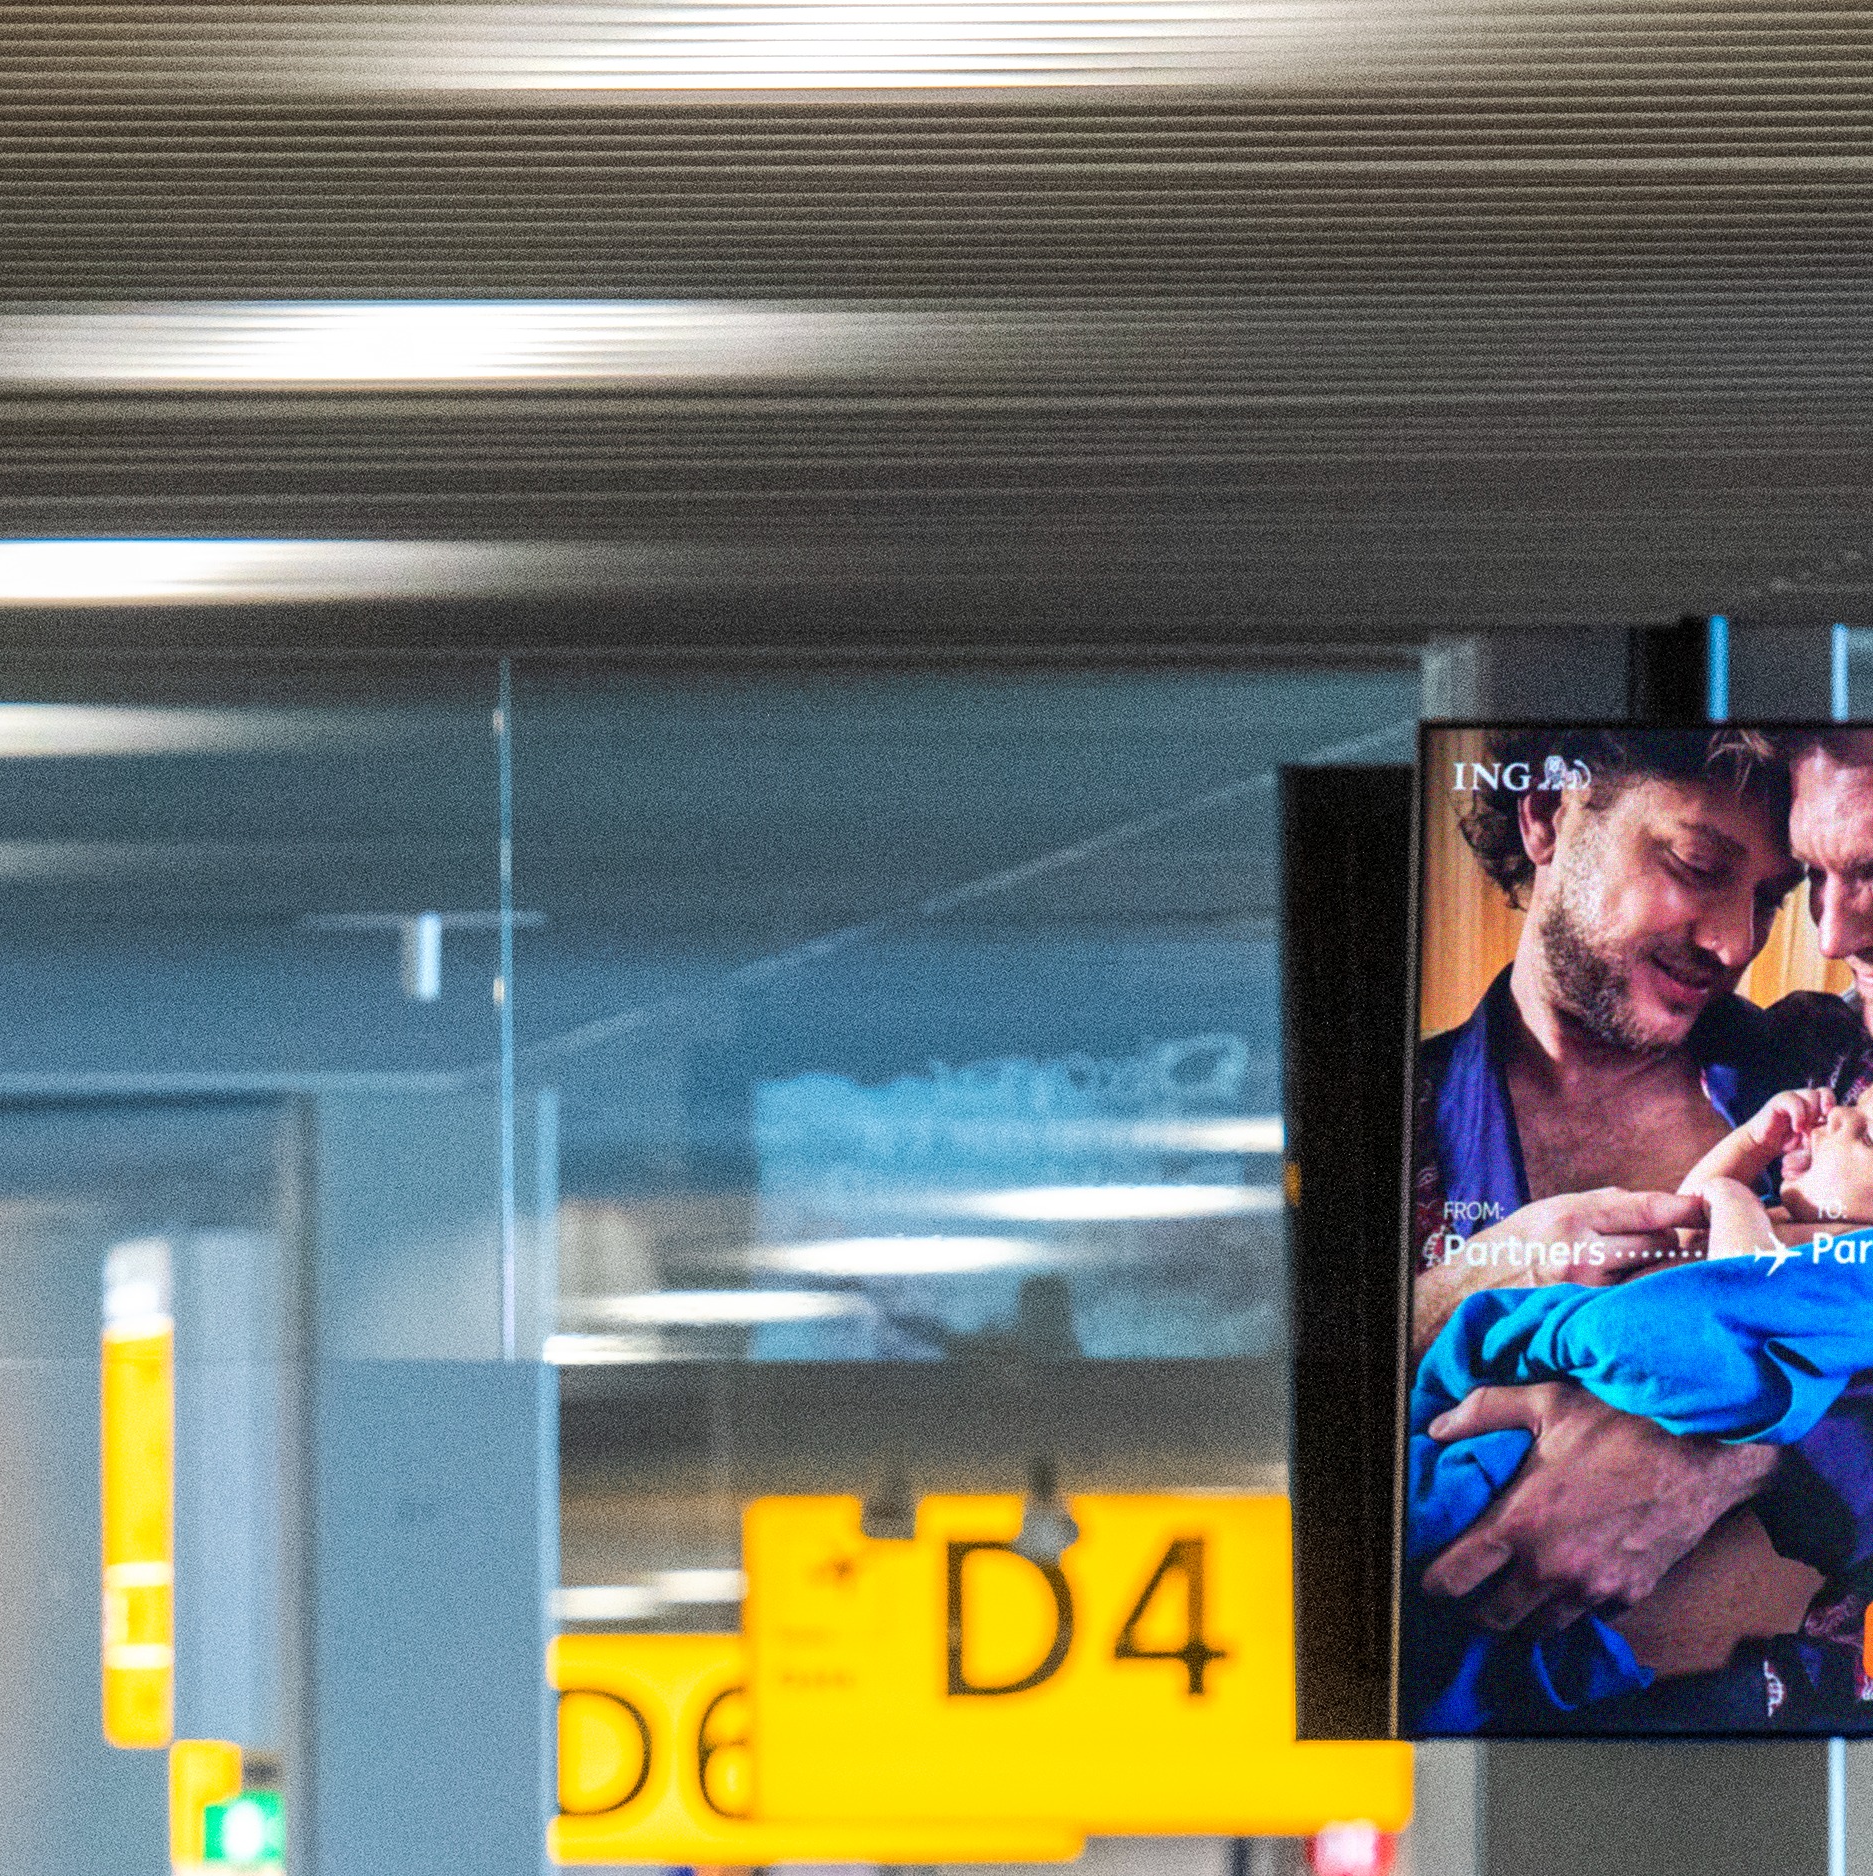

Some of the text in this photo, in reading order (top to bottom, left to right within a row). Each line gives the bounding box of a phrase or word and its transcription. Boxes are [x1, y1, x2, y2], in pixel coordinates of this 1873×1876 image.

[1452, 762, 1532, 792] ING
[1443, 1200, 1505, 1221] FROM:
[1443, 1234, 1606, 1266] Partners
[947, 1538, 1227, 1696] D4
